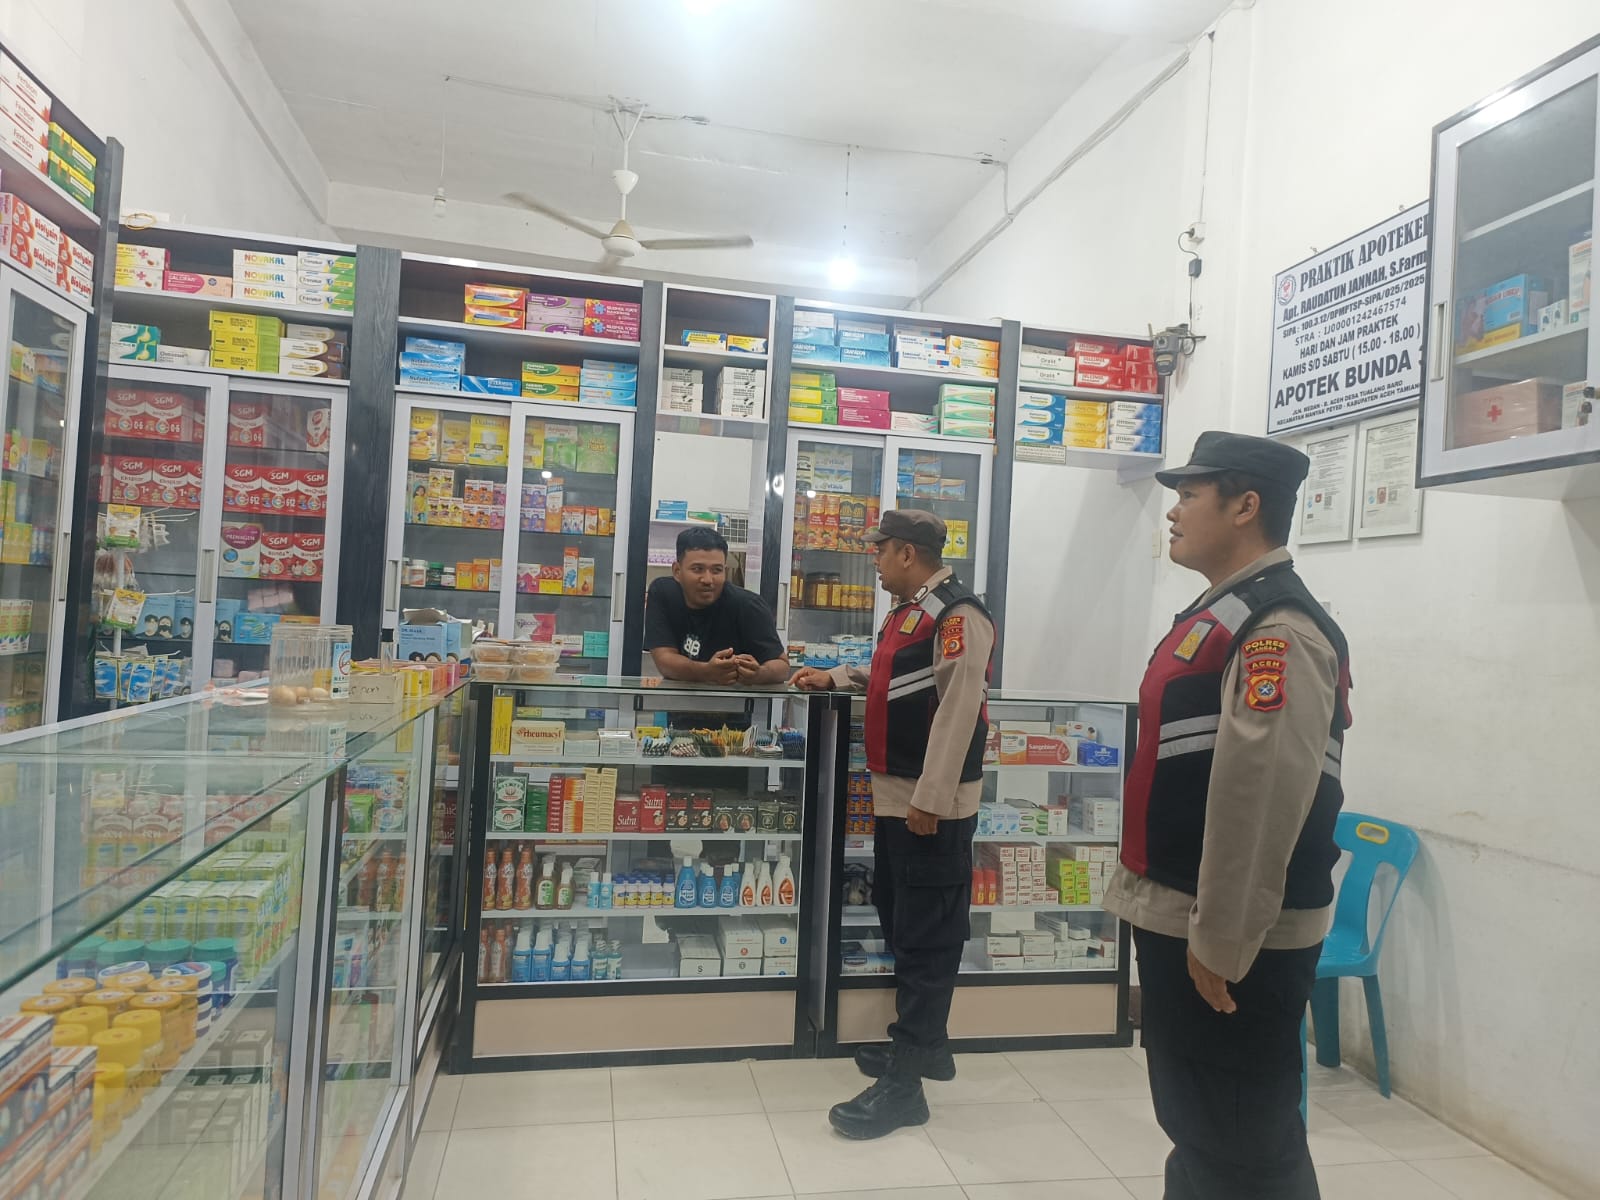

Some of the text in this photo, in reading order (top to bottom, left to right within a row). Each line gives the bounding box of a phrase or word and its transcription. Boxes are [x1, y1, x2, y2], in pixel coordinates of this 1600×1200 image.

[244, 254, 285, 265] NOVAKAL
[244, 271, 285, 282] NOVAKAL
[1300, 249, 1354, 293] PRAKTIK
[244, 288, 285, 299] NOVAKAL
[1301, 283, 1346, 316] RAUDATUN
[1283, 326, 1296, 338] SIPA
[1300, 314, 1398, 359] HARI DAN JAM PRAKTEK
[1295, 331, 1315, 346] STRA
[1283, 362, 1306, 381] KAMIS
[1308, 358, 1320, 373] S/D
[1323, 348, 1350, 368] SABTU
[1358, 336, 1381, 355] 15.00
[1390, 325, 1414, 345] 18.00
[1274, 371, 1340, 409] APOTEK
[1345, 349, 1412, 388] BUNDA
[1380, 389, 1395, 399] ACEH
[1397, 383, 1420, 394] TAMIAN
[117, 393, 136, 401] SGM
[155, 397, 173, 405] SGM
[238, 407, 256, 415] SGM
[122, 462, 143, 470] SGM
[161, 465, 182, 473] SGM
[234, 469, 253, 477] SGM
[270, 472, 289, 480] SGM
[306, 474, 324, 482] SGM
[268, 537, 288, 545] SGM
[302, 538, 320, 546] SGM
[1245, 640, 1285, 652] POLRES
[1252, 660, 1280, 669] ACEH
[644, 796, 663, 807] Sutra
[617, 815, 637, 826] Sutra
